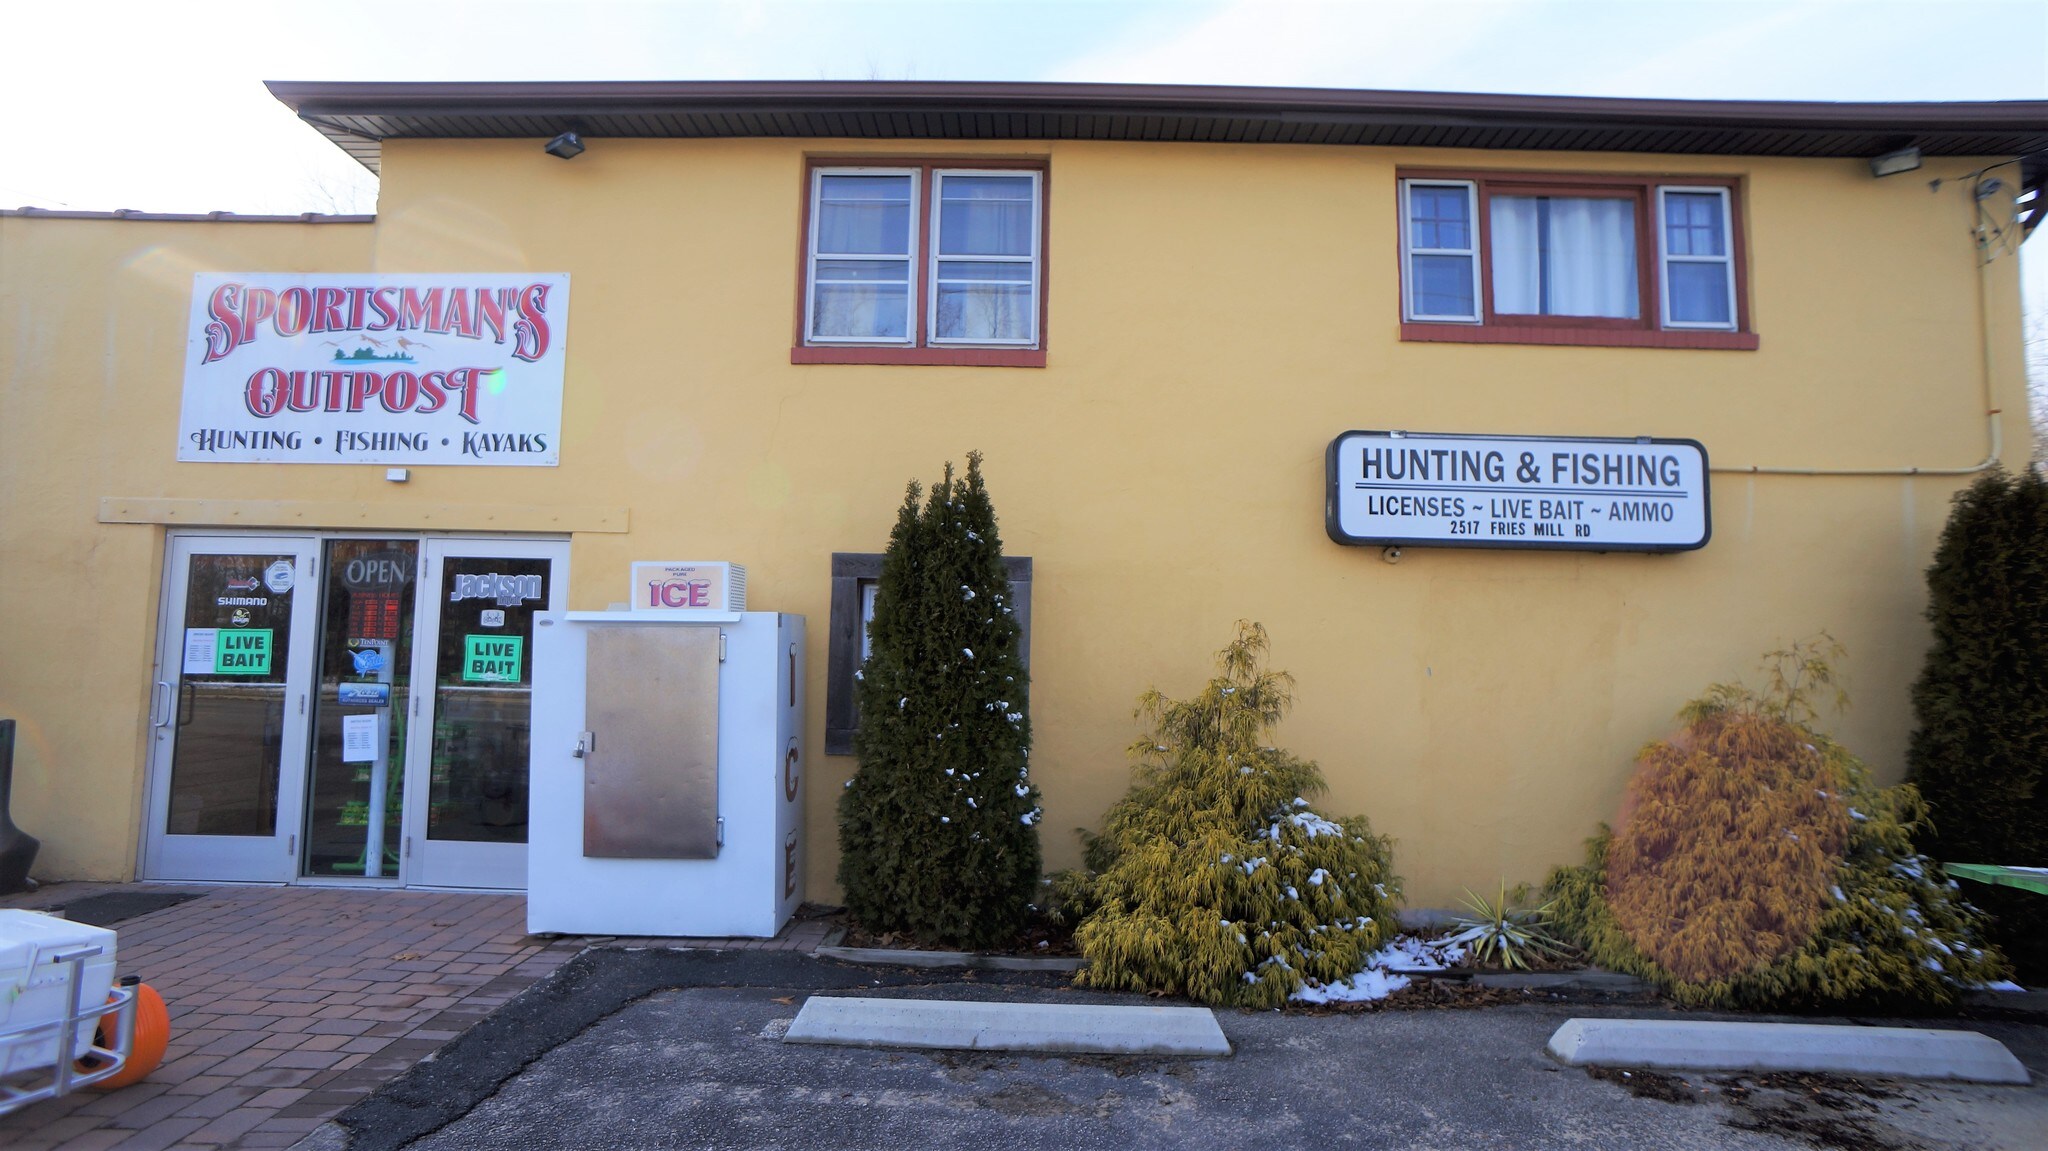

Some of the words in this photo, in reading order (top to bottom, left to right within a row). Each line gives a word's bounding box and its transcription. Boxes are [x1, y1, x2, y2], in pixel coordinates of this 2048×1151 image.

[202, 281, 553, 364] SPORTSMAN'S
[245, 367, 503, 425] OUTPOST
[191, 428, 302, 454] HUNTING
[336, 429, 429, 454] FISHING
[462, 431, 548, 459] KAYAKS
[1361, 447, 1505, 483] HUNTING
[1515, 451, 1541, 483] &
[1552, 452, 1681, 487] FISHING
[1368, 495, 1466, 518] LICENSES
[1490, 498, 1532, 520] LIVE
[1539, 500, 1584, 521] BAIT
[1608, 501, 1674, 522] AMMO
[1450, 520, 1480, 535] 2517
[1490, 521, 1526, 536] FRIES
[1533, 522, 1564, 537] MILL
[1575, 523, 1591, 538] RD
[347, 559, 406, 584] OPEN
[451, 573, 542, 601] jackson
[649, 578, 711, 607] ICE
[217, 597, 267, 606] SHIMANO
[225, 636, 264, 650] LIVE
[475, 642, 515, 657] LIVE
[222, 653, 265, 667] BAIT
[472, 660, 515, 675] BAIT
[785, 642, 801, 902] ICE
